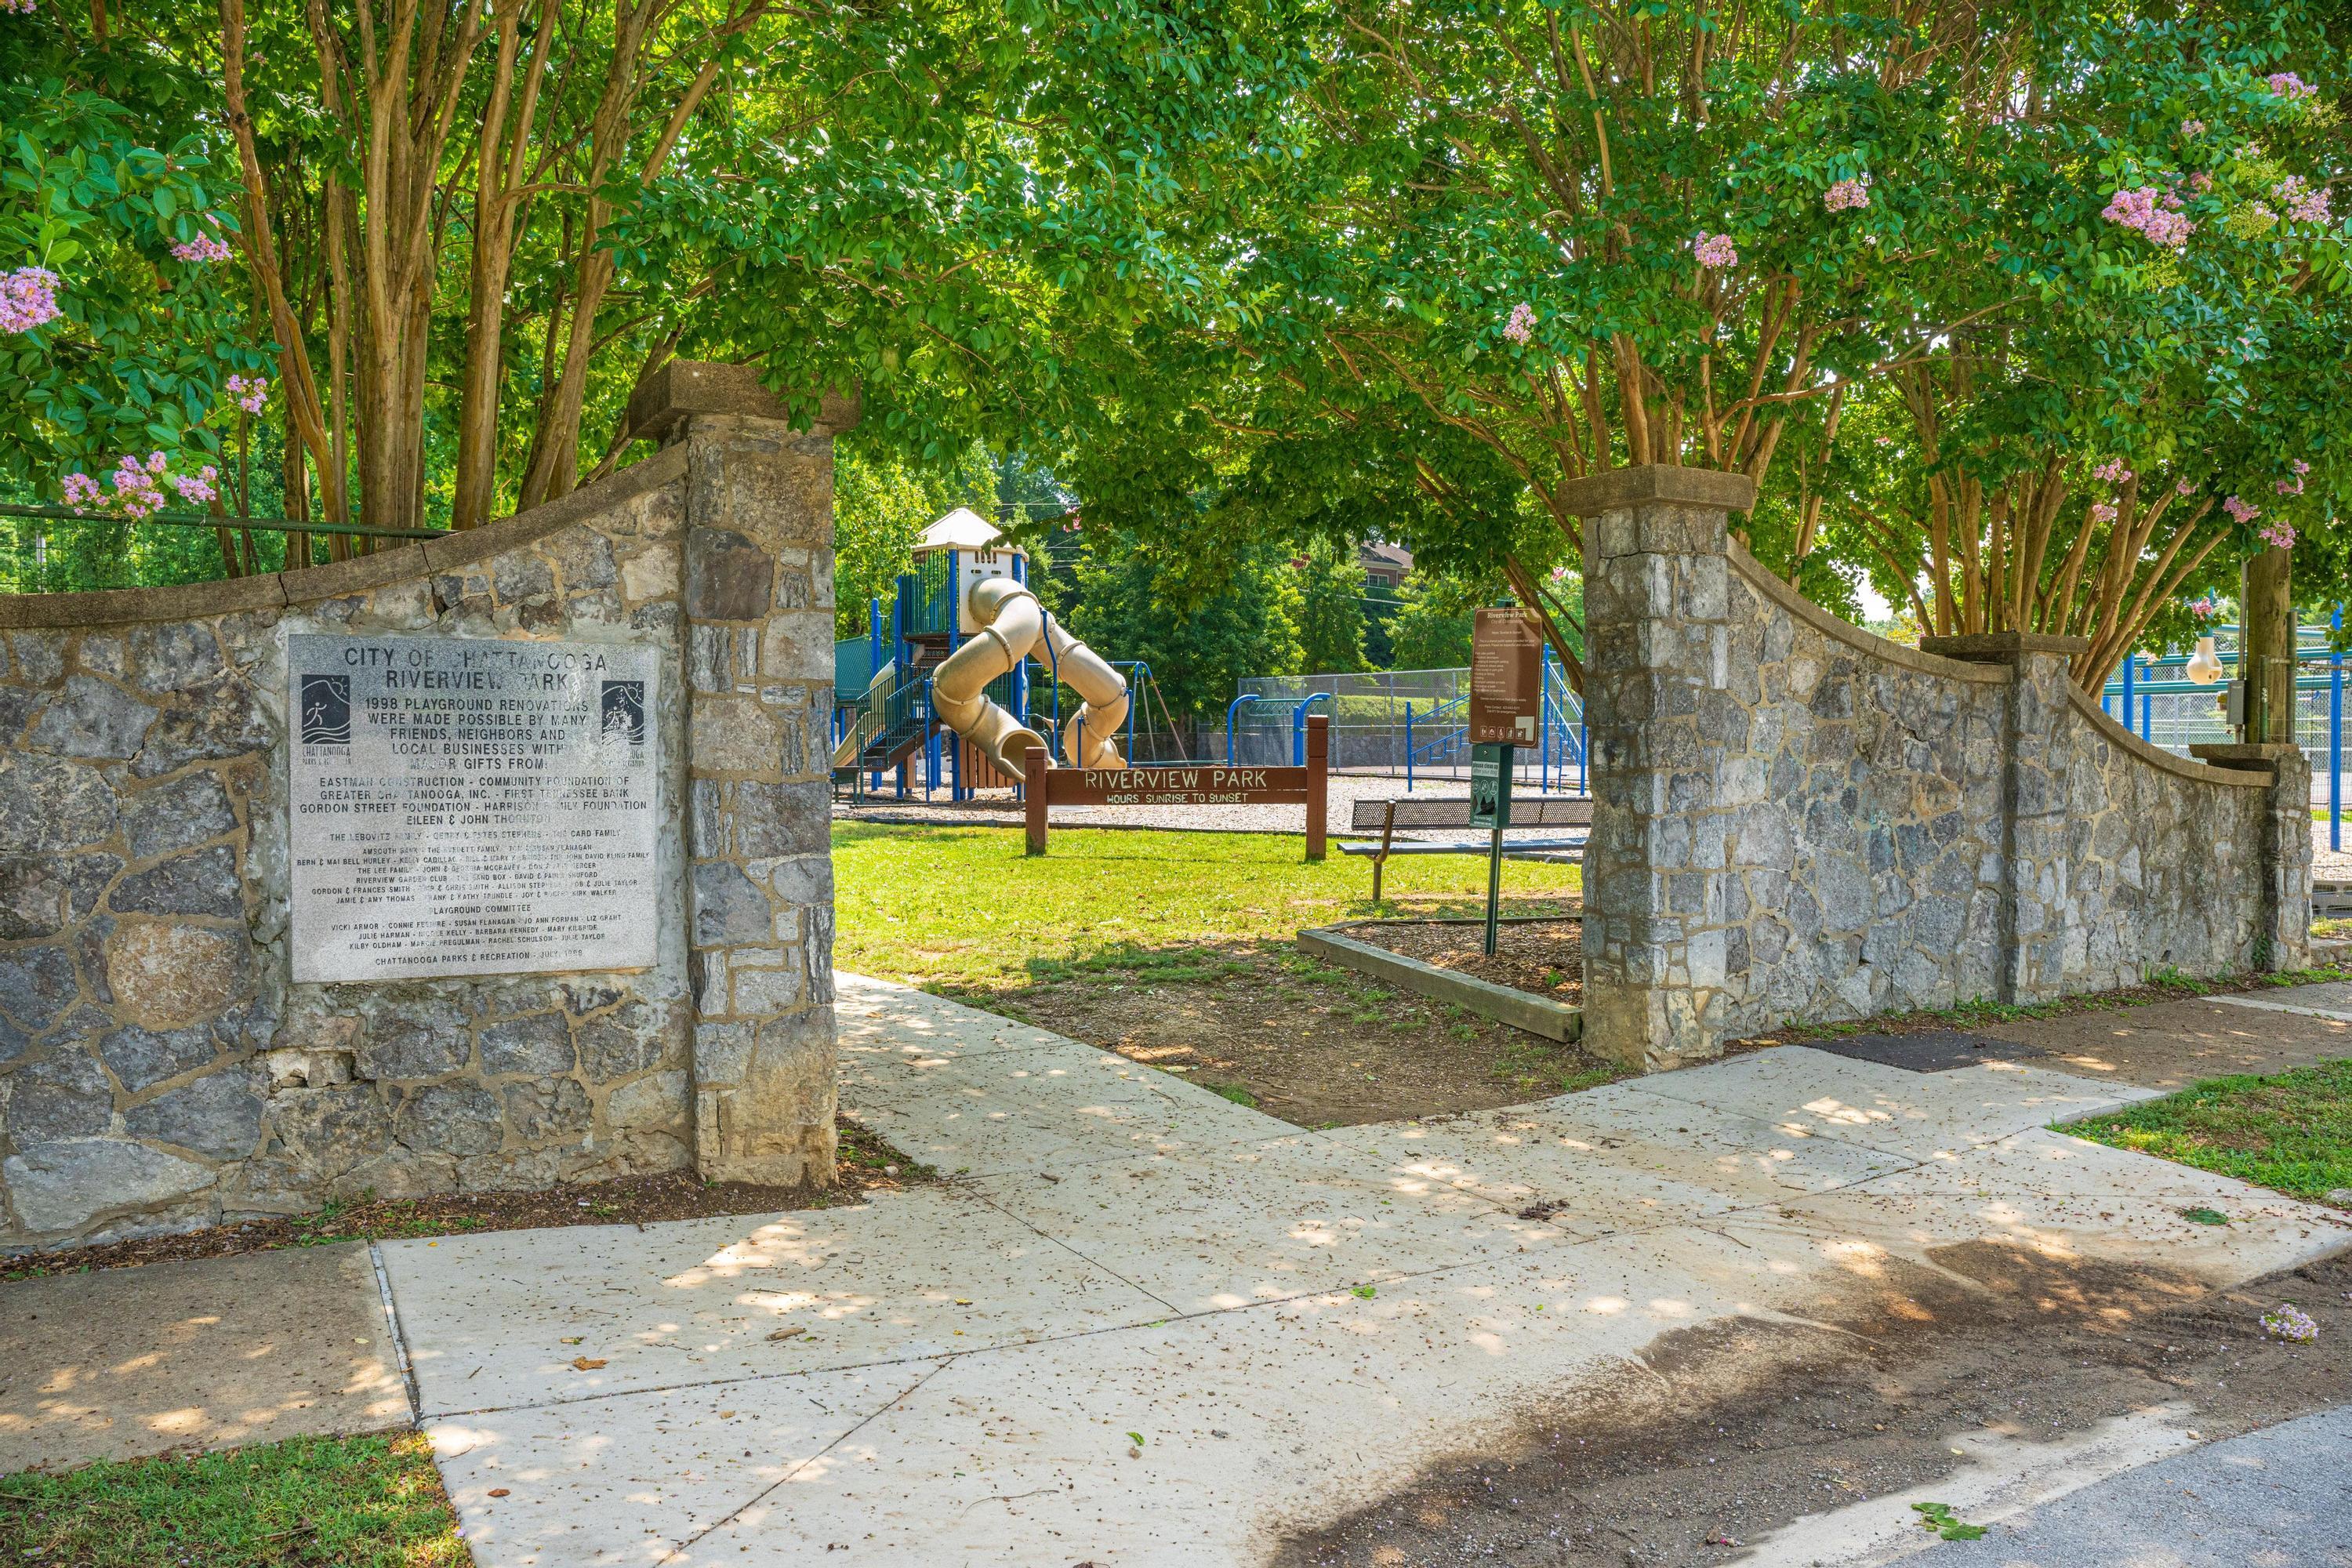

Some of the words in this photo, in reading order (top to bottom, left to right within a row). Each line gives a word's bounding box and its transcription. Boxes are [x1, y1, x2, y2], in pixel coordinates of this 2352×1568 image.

[345, 648, 394, 666] CITY
[408, 650, 433, 666] OF
[387, 670, 502, 690] RIVERVIEW
[365, 698, 397, 710] 1998
[405, 699, 492, 710] PLAYGROUND
[500, 700, 588, 712] RENOVATIONS
[368, 713, 405, 724] WERE
[413, 713, 450, 724] MADE
[459, 714, 522, 726] POSSIBLE
[529, 715, 543, 726] BY
[552, 715, 586, 726] MANY
[390, 728, 451, 741] FRIENDS,
[459, 728, 532, 741] NEIGHBORS
[541, 729, 565, 740] AND
[393, 744, 436, 754] LOCAL
[444, 743, 524, 755] BUSINESSES
[533, 744, 564, 754] WITH
[464, 758, 502, 769] GIFTS
[509, 758, 547, 769] FROM:
[321, 778, 373, 786] EASTMAN
[480, 777, 541, 786] COMMUNITY
[546, 777, 611, 786] FOUNDATION
[1085, 770, 1198, 789] RIVERVIEW
[1214, 770, 1267, 787] PARK
[321, 791, 371, 800] GREATER
[469, 789, 491, 799] INC.
[505, 789, 533, 798] FIRST
[1107, 794, 1138, 803] HOURS
[1146, 793, 1188, 803] SUNRISE
[1193, 793, 1204, 802] TO
[1209, 793, 1248, 802] SUNSET
[300, 804, 348, 813] GORDON
[354, 804, 396, 813] STREET
[402, 802, 470, 812] FOUNDATION
[485, 802, 539, 811] HARRISON
[584, 801, 647, 810] FOUNDATION
[407, 815, 442, 825] EILEEN
[449, 815, 455, 825] &
[460, 815, 488, 824] JOHN
[439, 938, 480, 946] PREGULMAN
[376, 956, 437, 965] CHATTANOOGA
